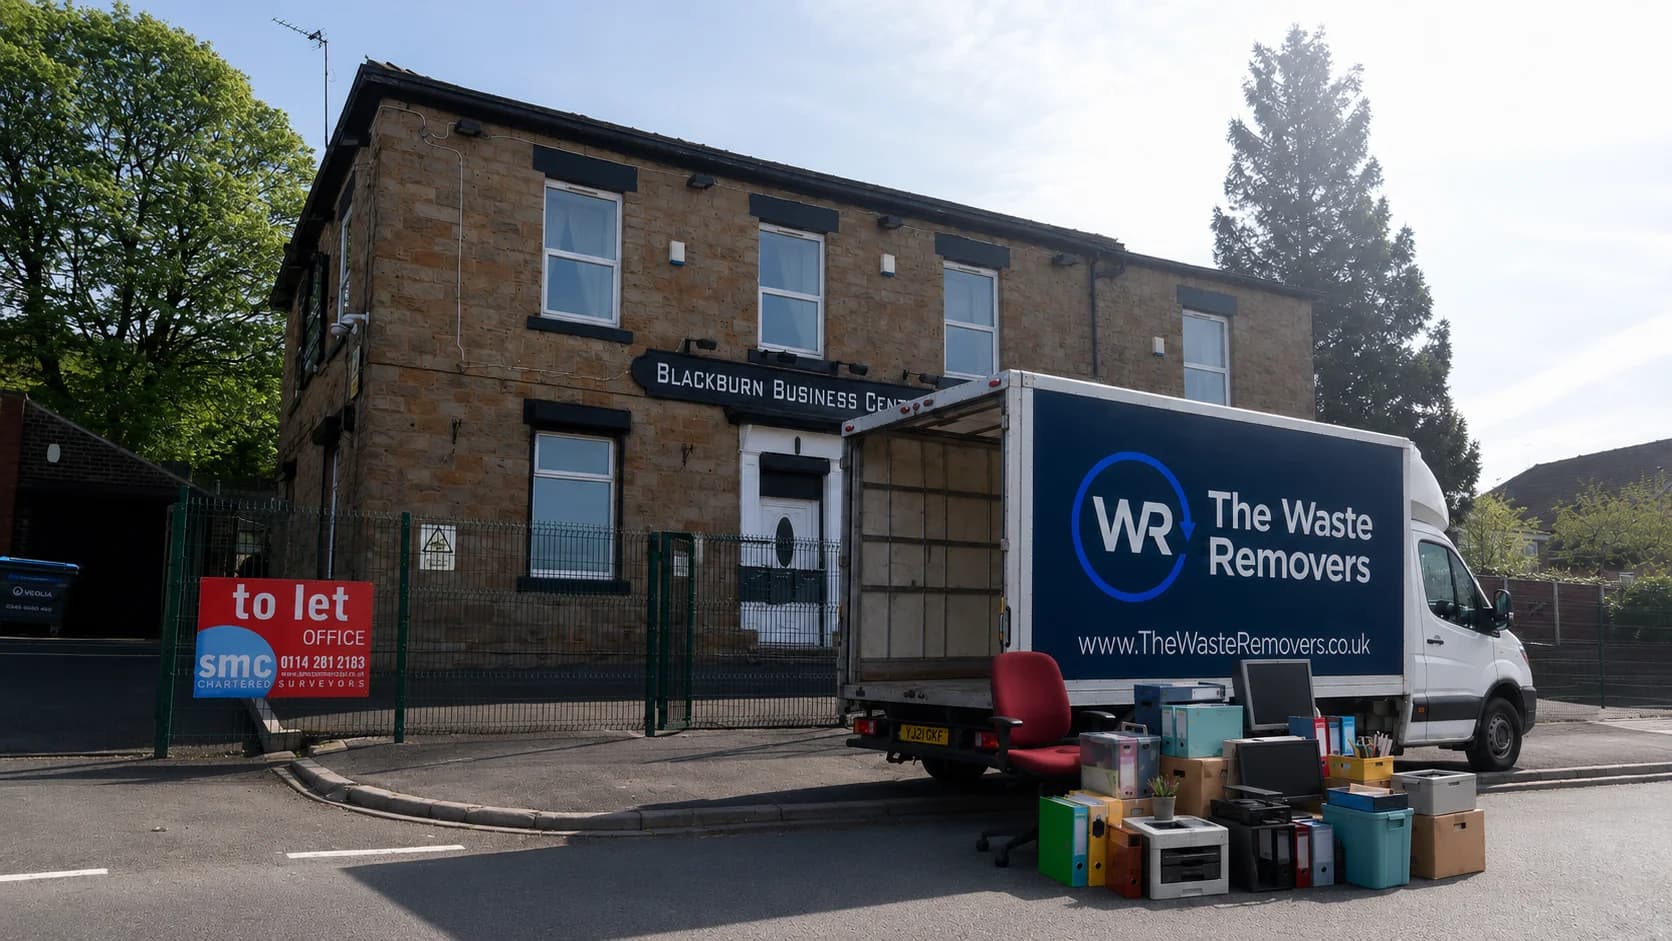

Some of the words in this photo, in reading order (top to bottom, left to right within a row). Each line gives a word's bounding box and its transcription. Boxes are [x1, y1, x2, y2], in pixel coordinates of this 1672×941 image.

[866, 391, 910, 412] CEN
[1092, 495, 1173, 556] WR
[1208, 489, 1272, 533] The
[1281, 498, 1373, 541] Waste
[1208, 536, 1372, 583] Removers
[24, 589, 52, 598] VEOLIA
[232, 583, 276, 620] to
[294, 584, 349, 622] let
[303, 629, 366, 646] OFFICE
[1078, 630, 1371, 656] www.TheWasteRemovers.co.uk
[198, 654, 272, 679] smc
[281, 655, 309, 669] 0114
[313, 655, 334, 669] 281
[337, 655, 365, 669] 2183
[197, 679, 271, 689] CHARTERED
[278, 679, 365, 688] SURVEYORS
